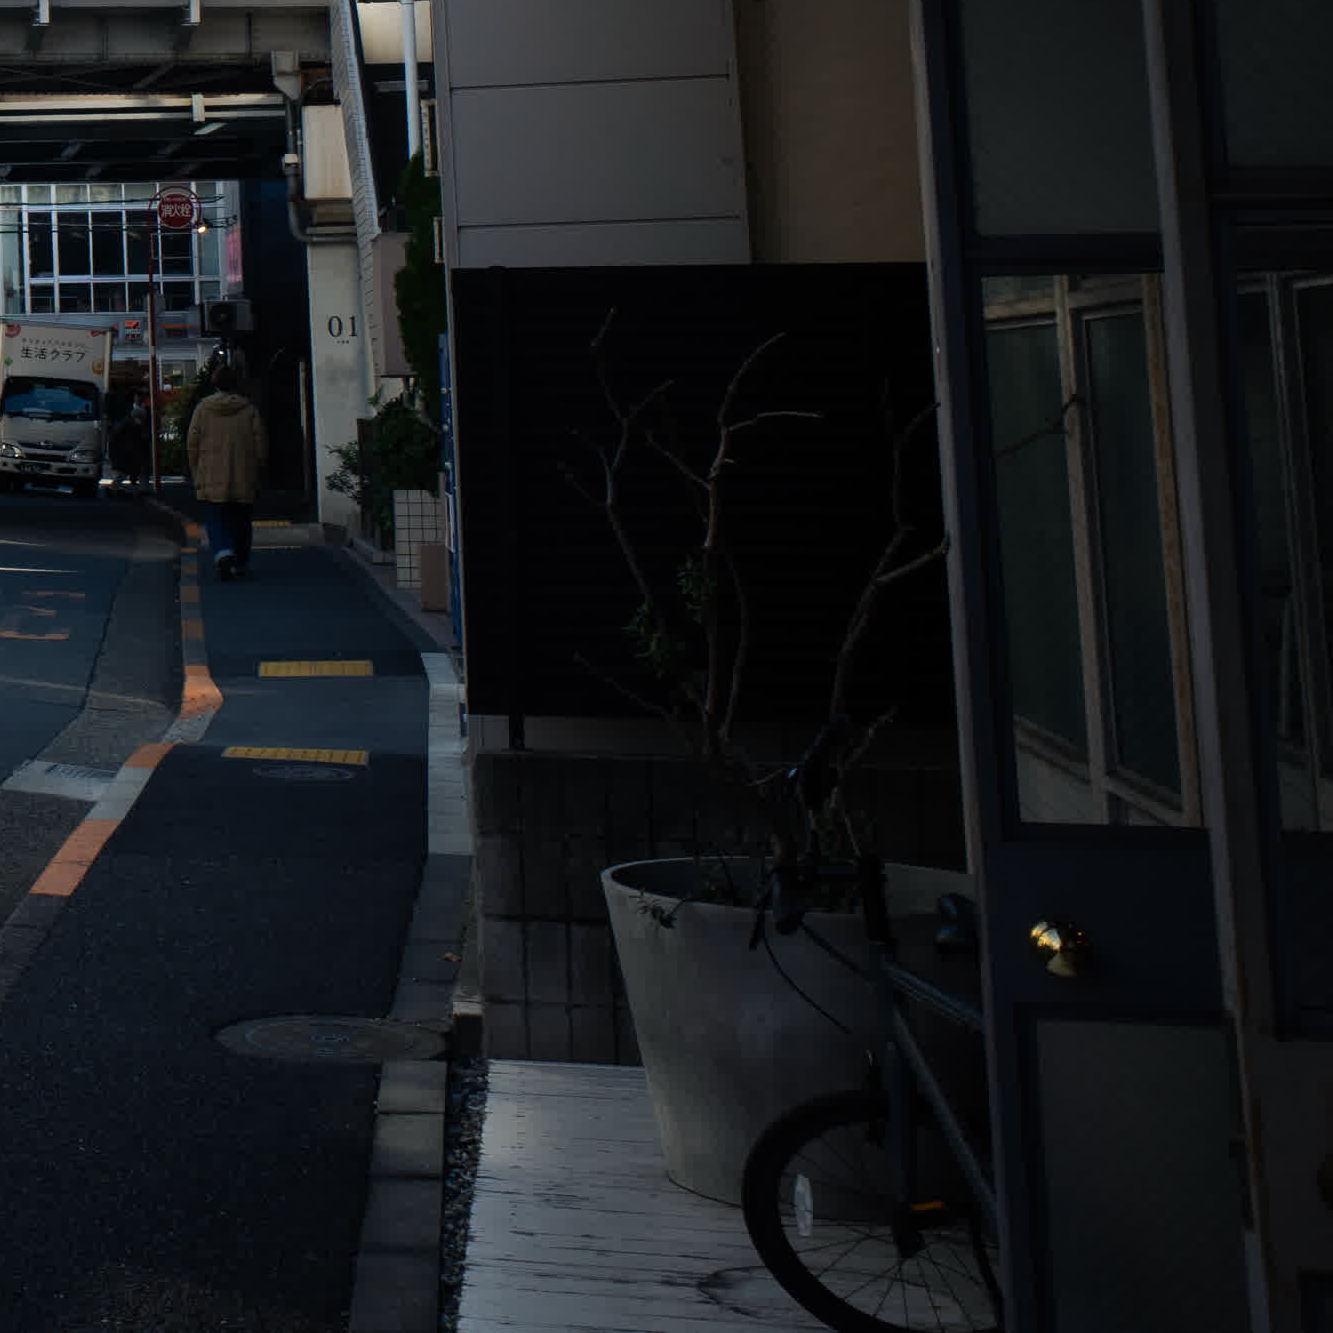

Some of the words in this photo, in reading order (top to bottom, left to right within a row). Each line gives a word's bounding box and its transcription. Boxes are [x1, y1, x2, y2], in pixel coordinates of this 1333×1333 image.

[161, 203, 191, 218] 消火栓
[327, 315, 358, 338] 01
